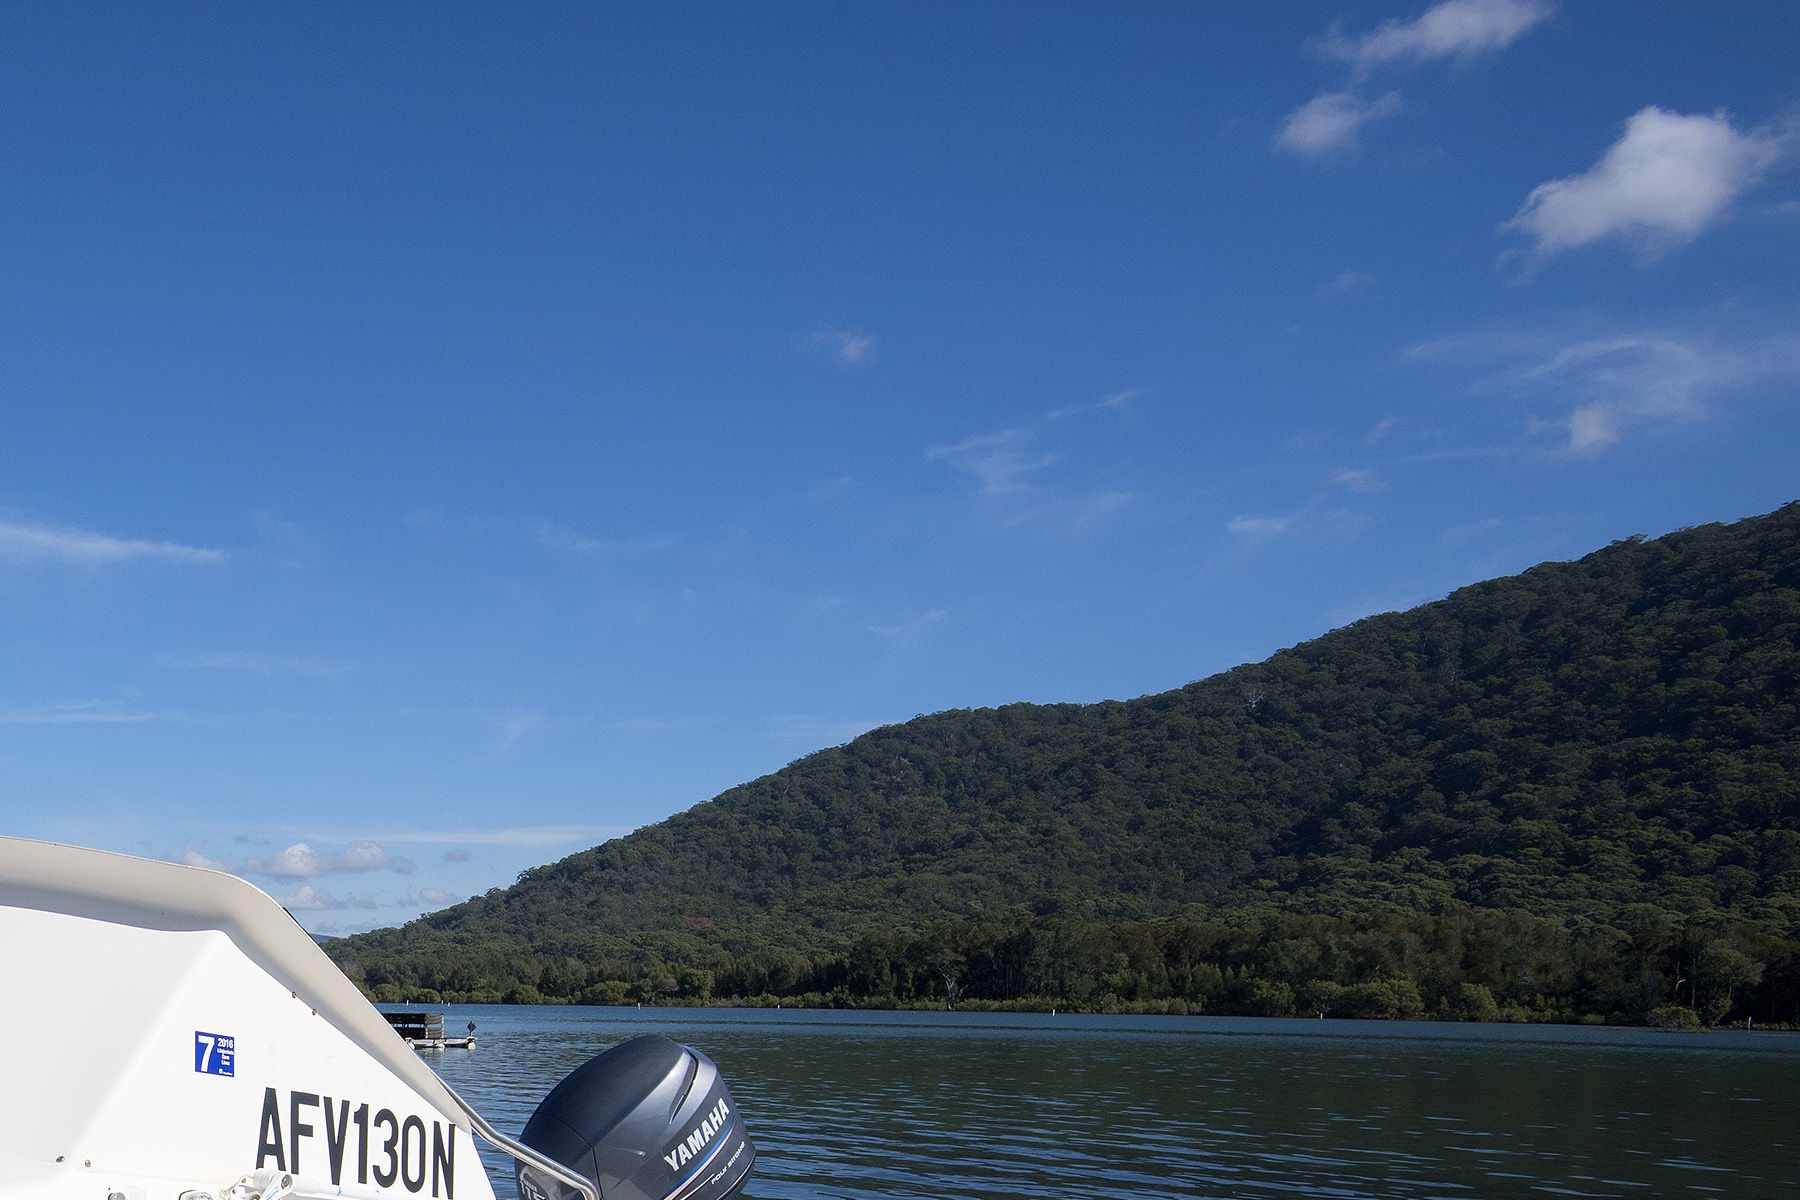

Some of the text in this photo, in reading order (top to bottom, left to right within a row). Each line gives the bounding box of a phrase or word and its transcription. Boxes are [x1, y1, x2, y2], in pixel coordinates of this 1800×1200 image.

[198, 1034, 215, 1072] 7
[217, 1037, 234, 1049] 2016
[255, 1086, 456, 1200] AFV130N
[663, 1097, 730, 1172] YAMAHA
